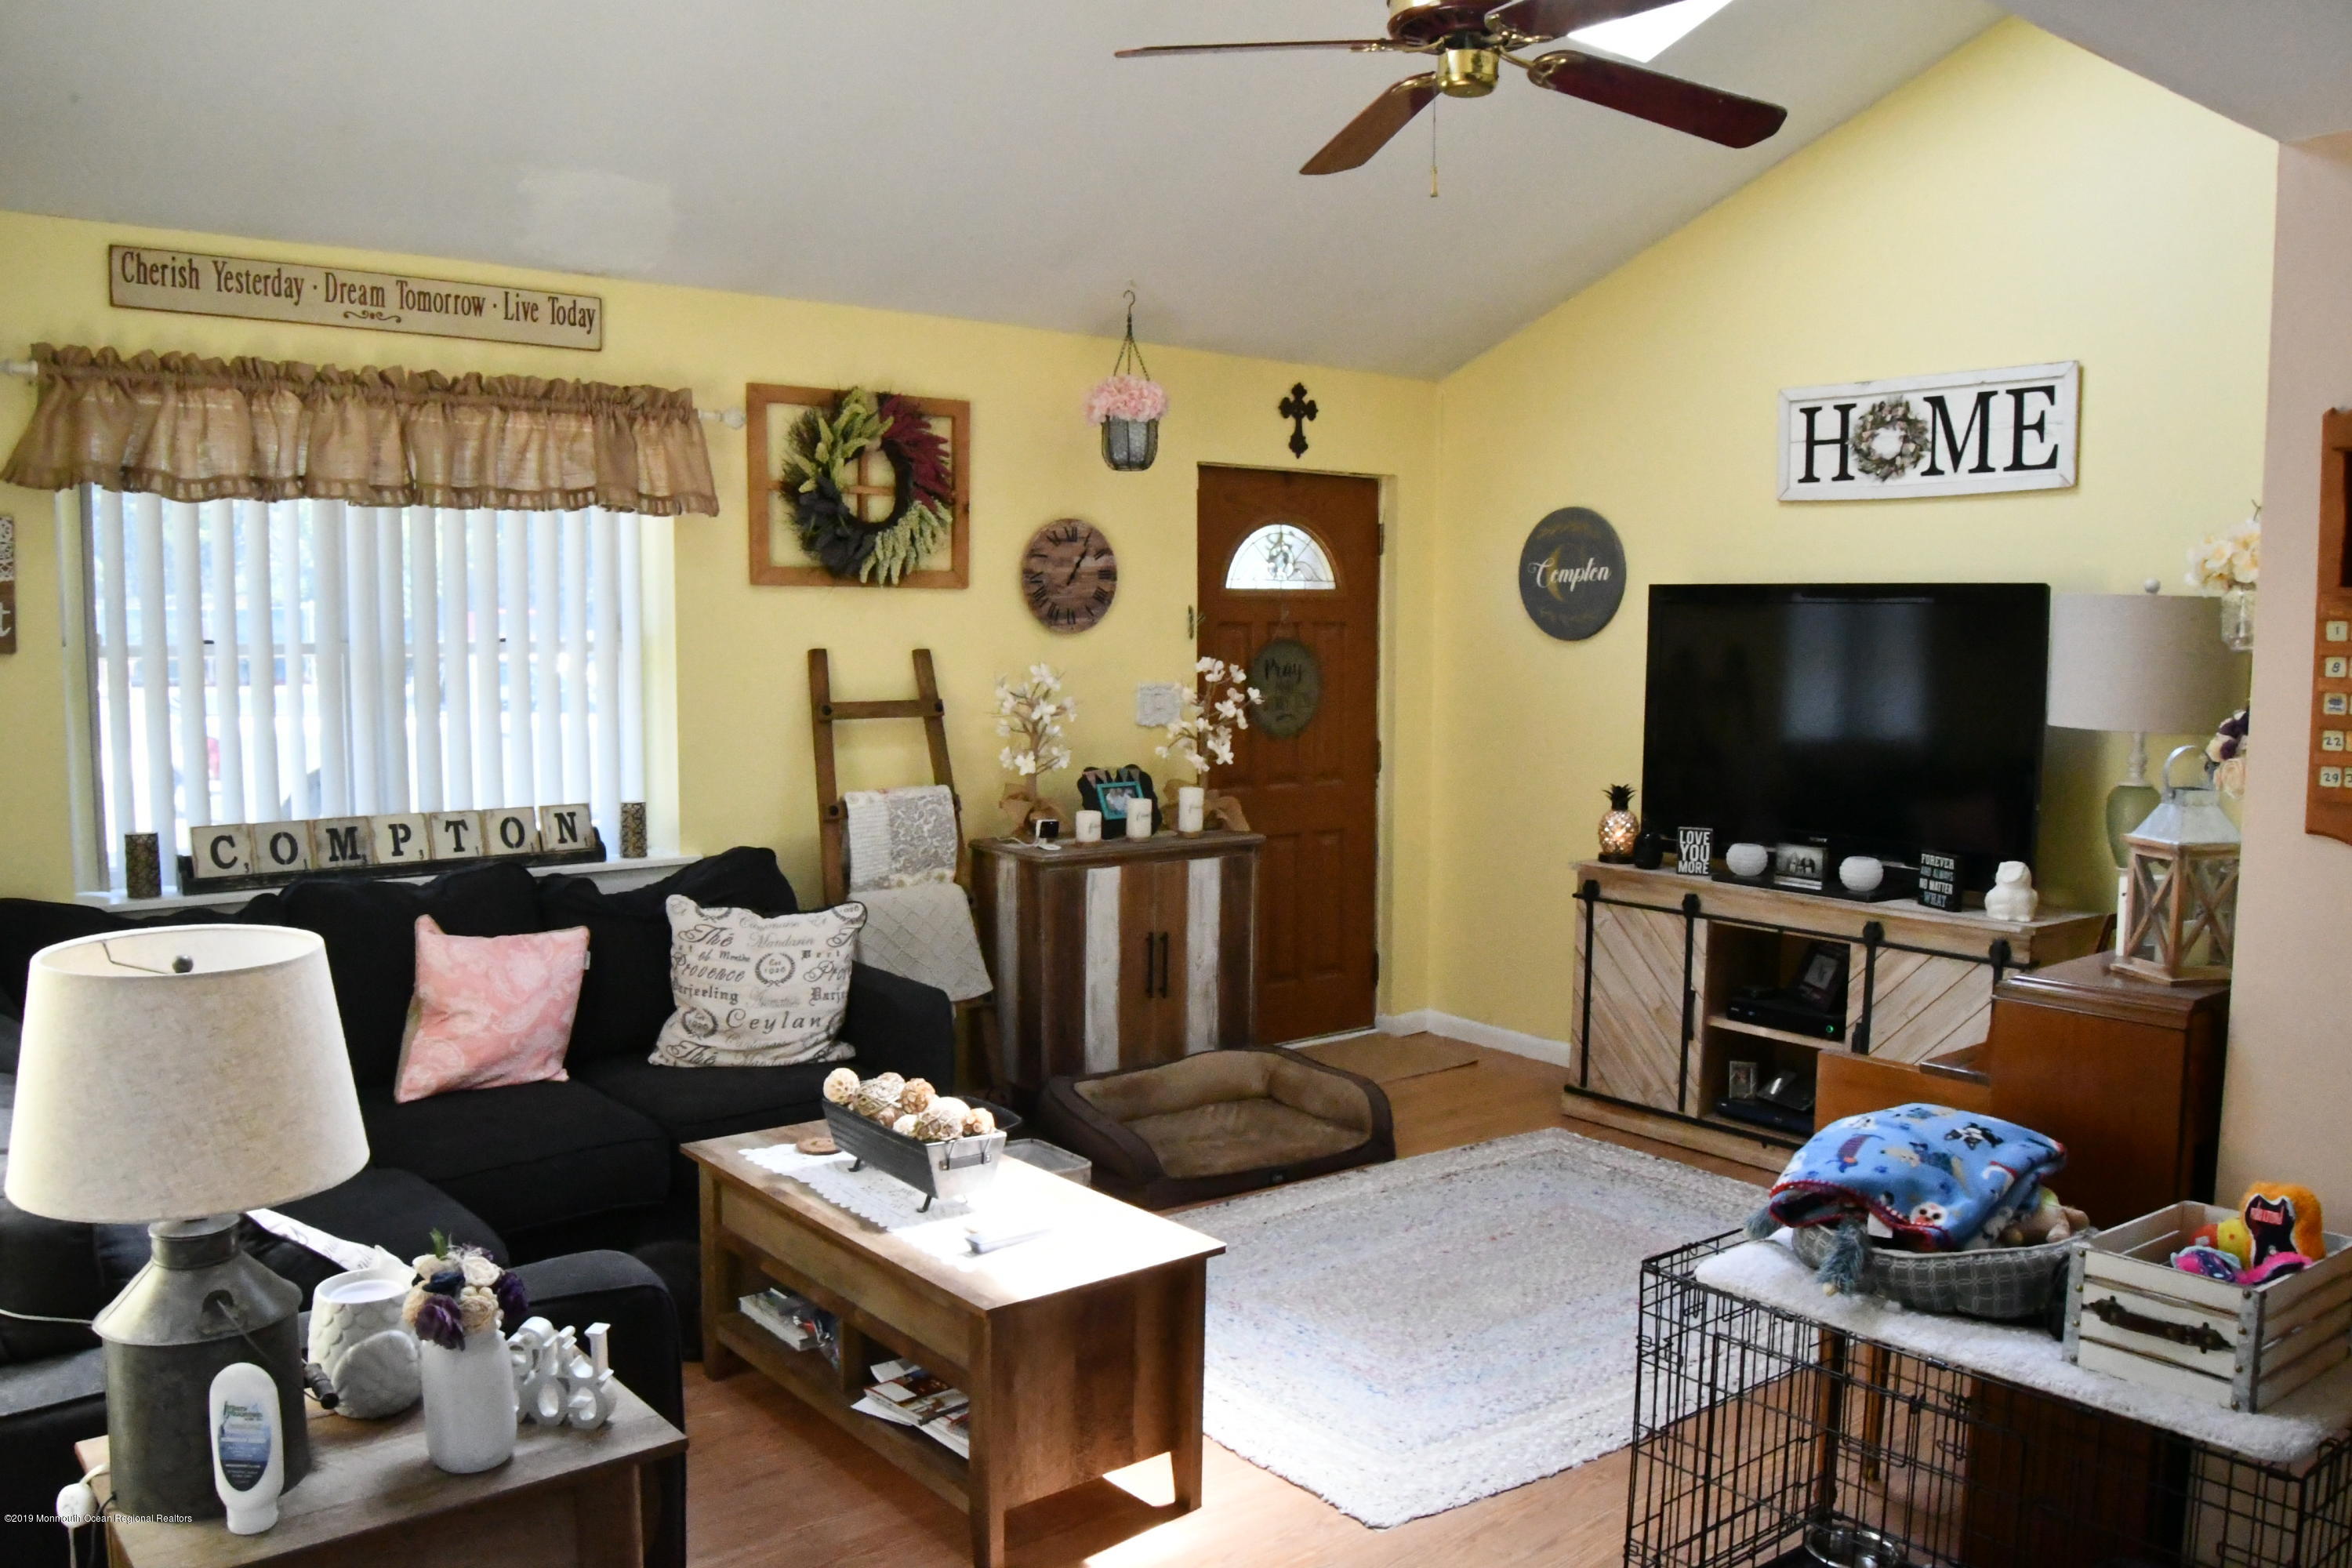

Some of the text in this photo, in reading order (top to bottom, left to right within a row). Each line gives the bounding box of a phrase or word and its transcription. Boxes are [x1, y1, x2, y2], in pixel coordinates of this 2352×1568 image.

[121, 251, 596, 335] Cherish Yesterday Dream Tomorrow Live Today
[1527, 557, 1612, 592] Compton
[2332, 661, 2341, 673] 8
[2325, 735, 2342, 747] 22
[2323, 771, 2339, 783] 29
[209, 811, 578, 870] COMPTON
[1679, 830, 1711, 845] LOVE
[1679, 844, 1711, 862] YOU
[1678, 860, 1710, 875] MORE
[1921, 853, 1955, 870] FOREVER
[1929, 880, 1954, 895] MATTER
[726, 1008, 821, 1034] Ceylan
